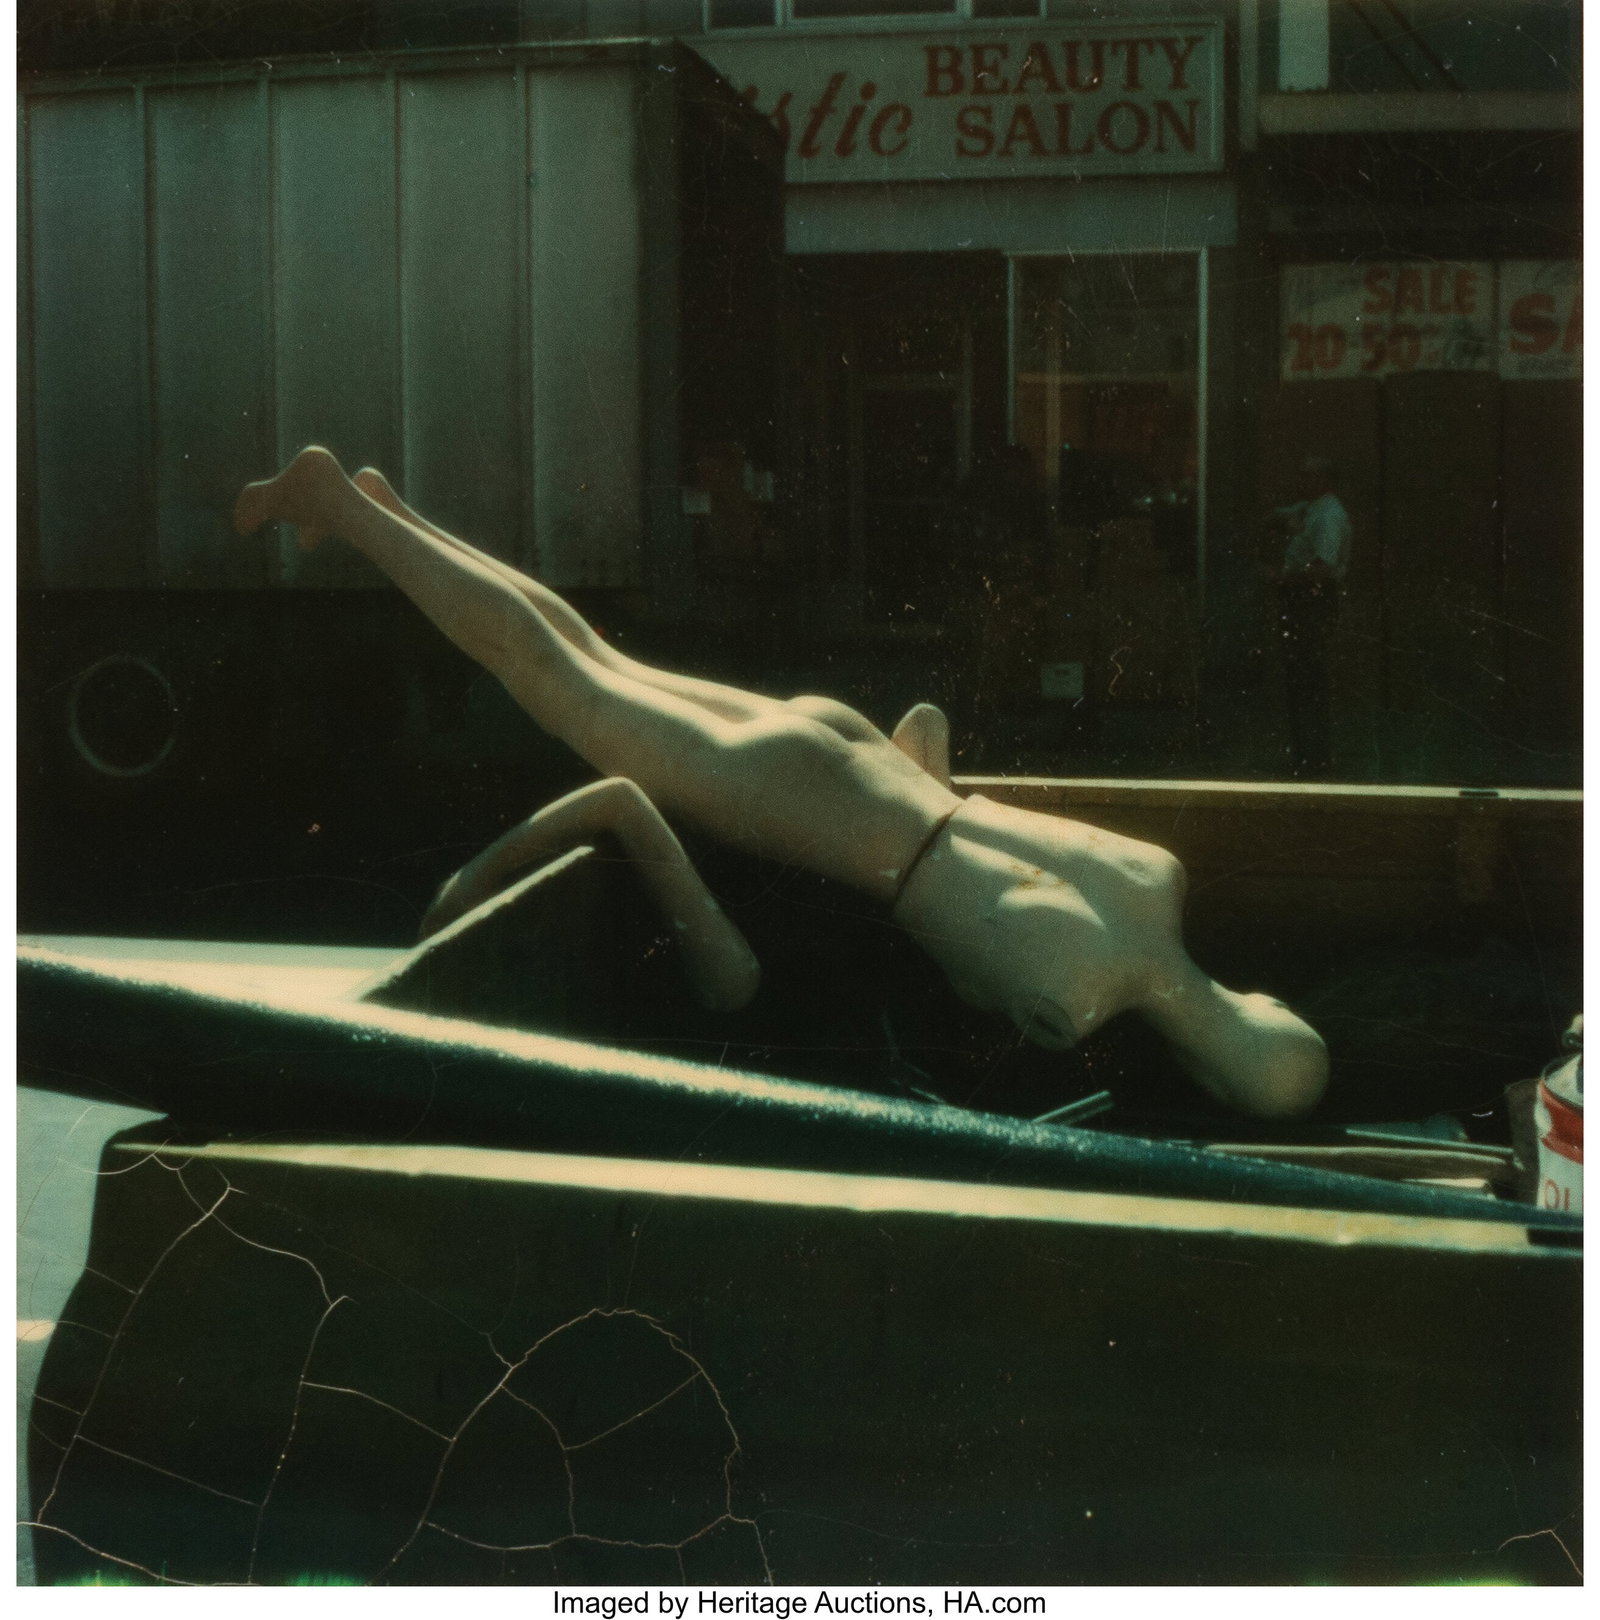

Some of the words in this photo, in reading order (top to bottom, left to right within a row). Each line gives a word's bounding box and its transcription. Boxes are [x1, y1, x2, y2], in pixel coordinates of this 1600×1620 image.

[923, 36, 1203, 97] BEAUTY
[743, 72, 913, 158] stic
[955, 101, 1199, 158] SALON
[1363, 266, 1477, 314] SALE
